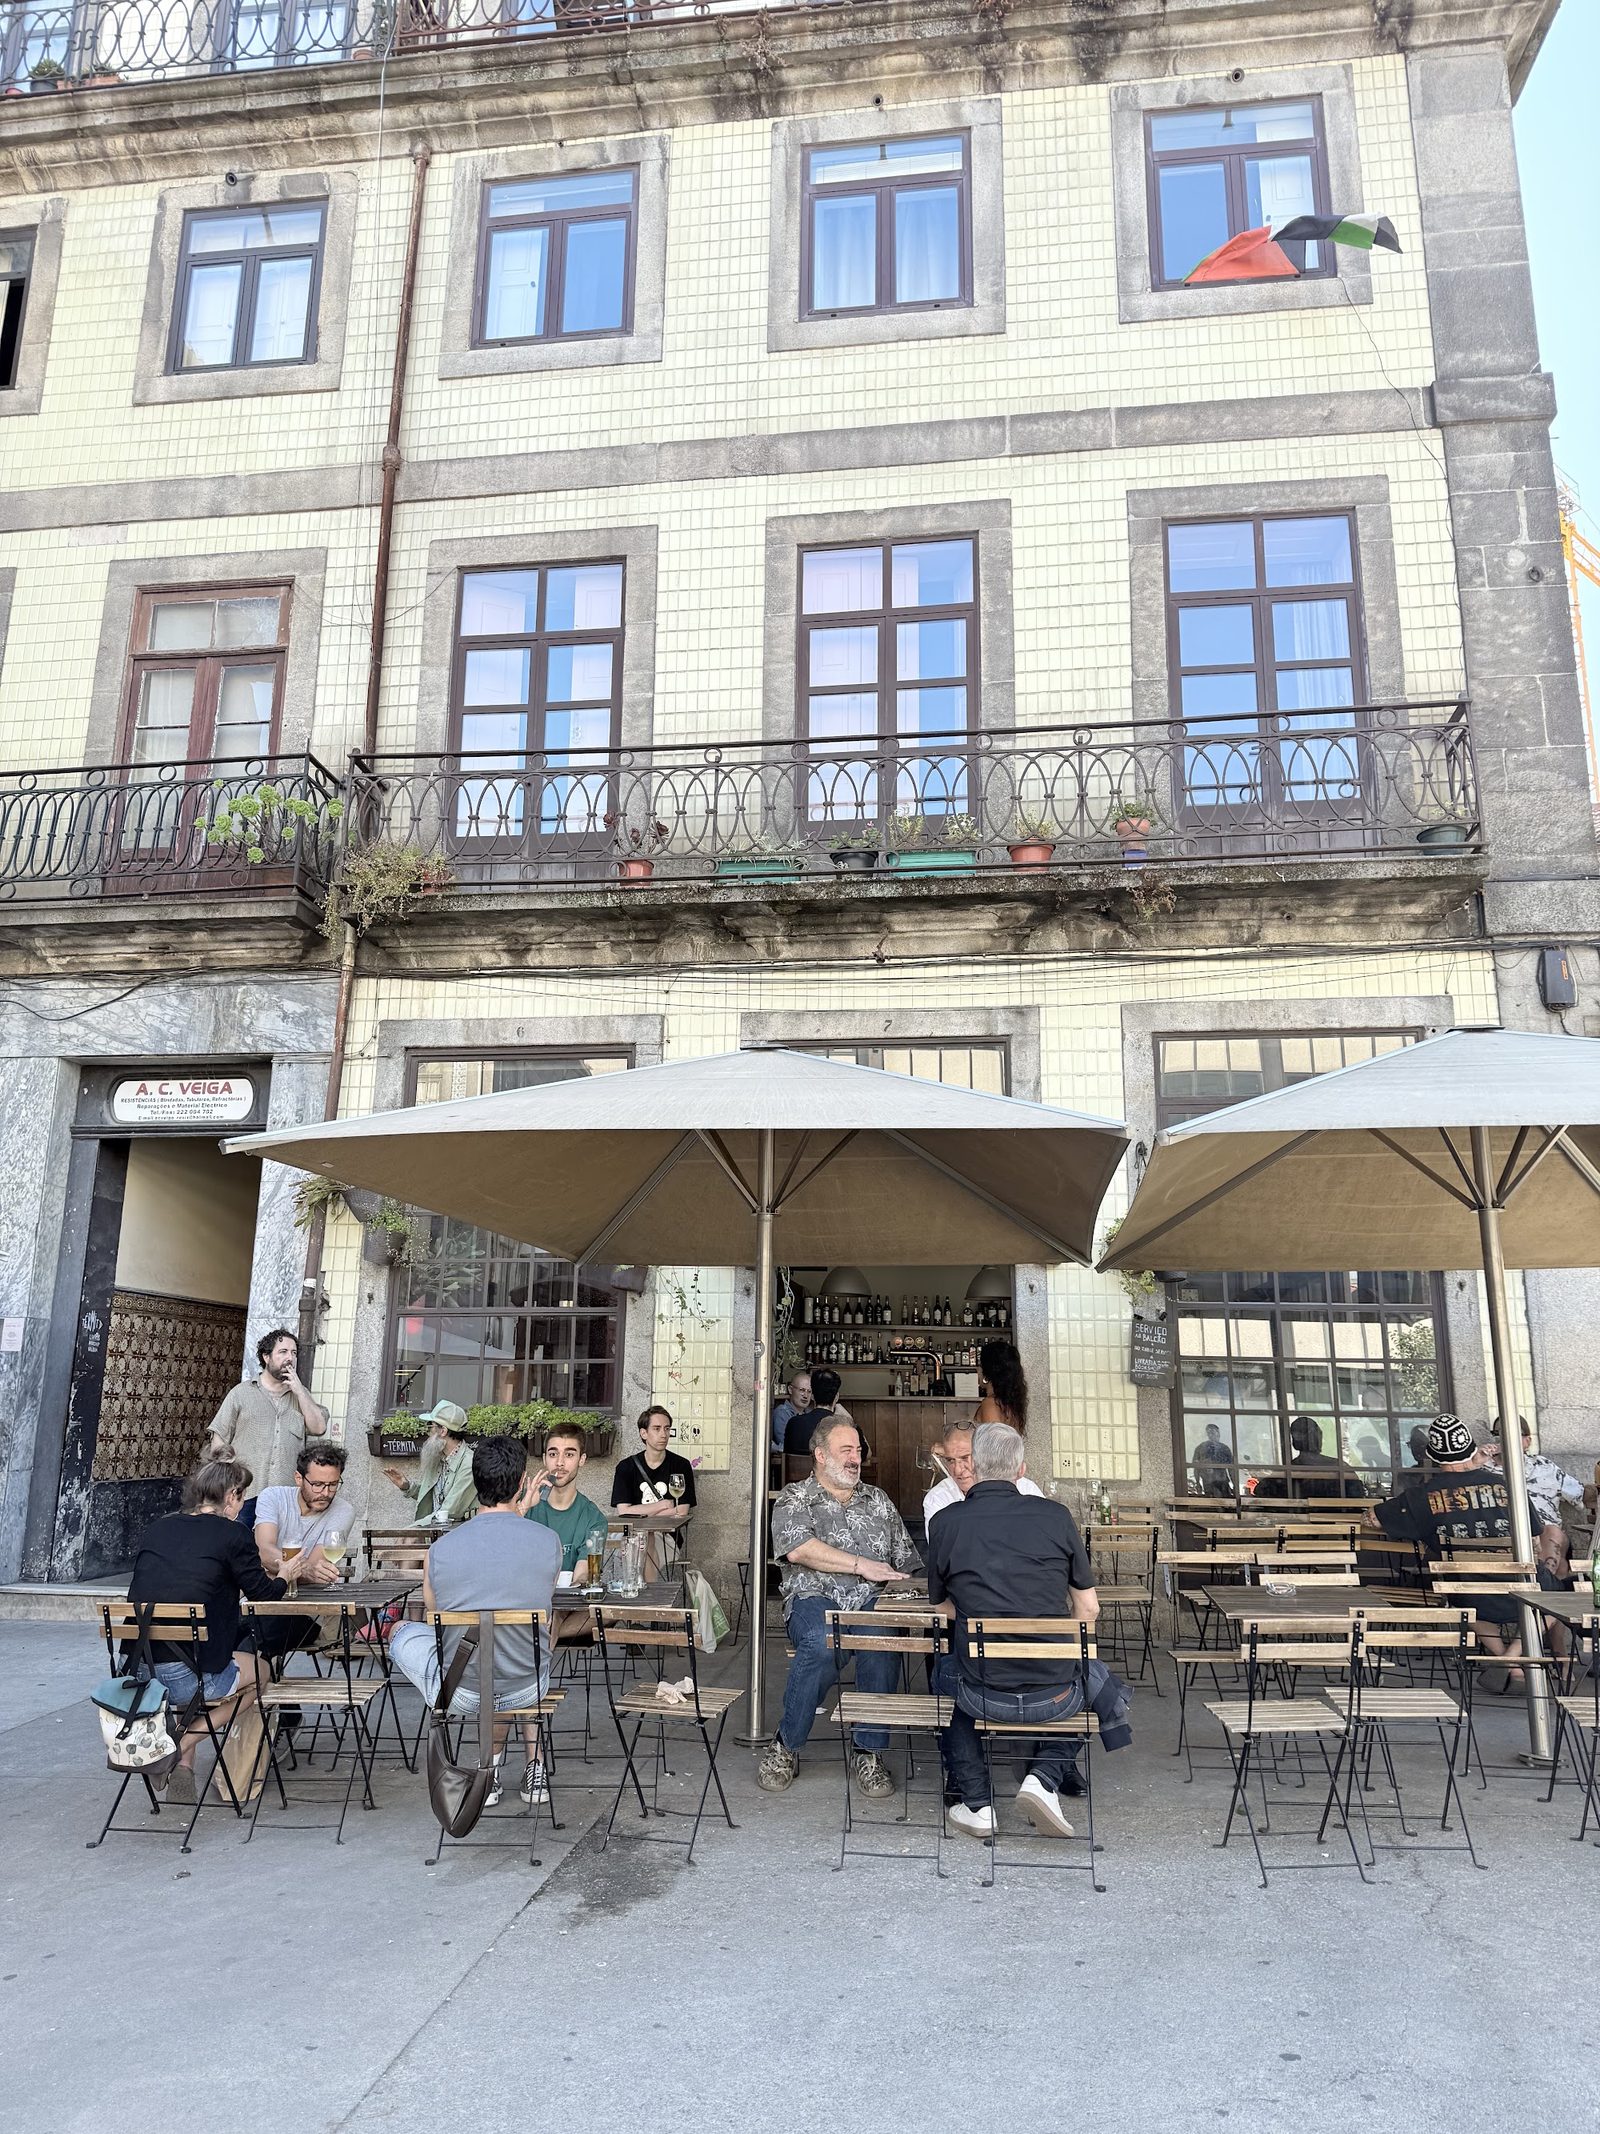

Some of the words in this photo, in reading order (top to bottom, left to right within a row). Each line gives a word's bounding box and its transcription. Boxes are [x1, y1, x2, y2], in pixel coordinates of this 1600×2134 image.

[516, 1025, 525, 1038] 6
[883, 1019, 893, 1032] 7
[135, 1082, 153, 1096] A.
[158, 1082, 173, 1096] C.
[179, 1081, 233, 1095] VEIGA
[387, 1438, 417, 1452] TÉRMITA
[1427, 1483, 1508, 1516] DESTRO
